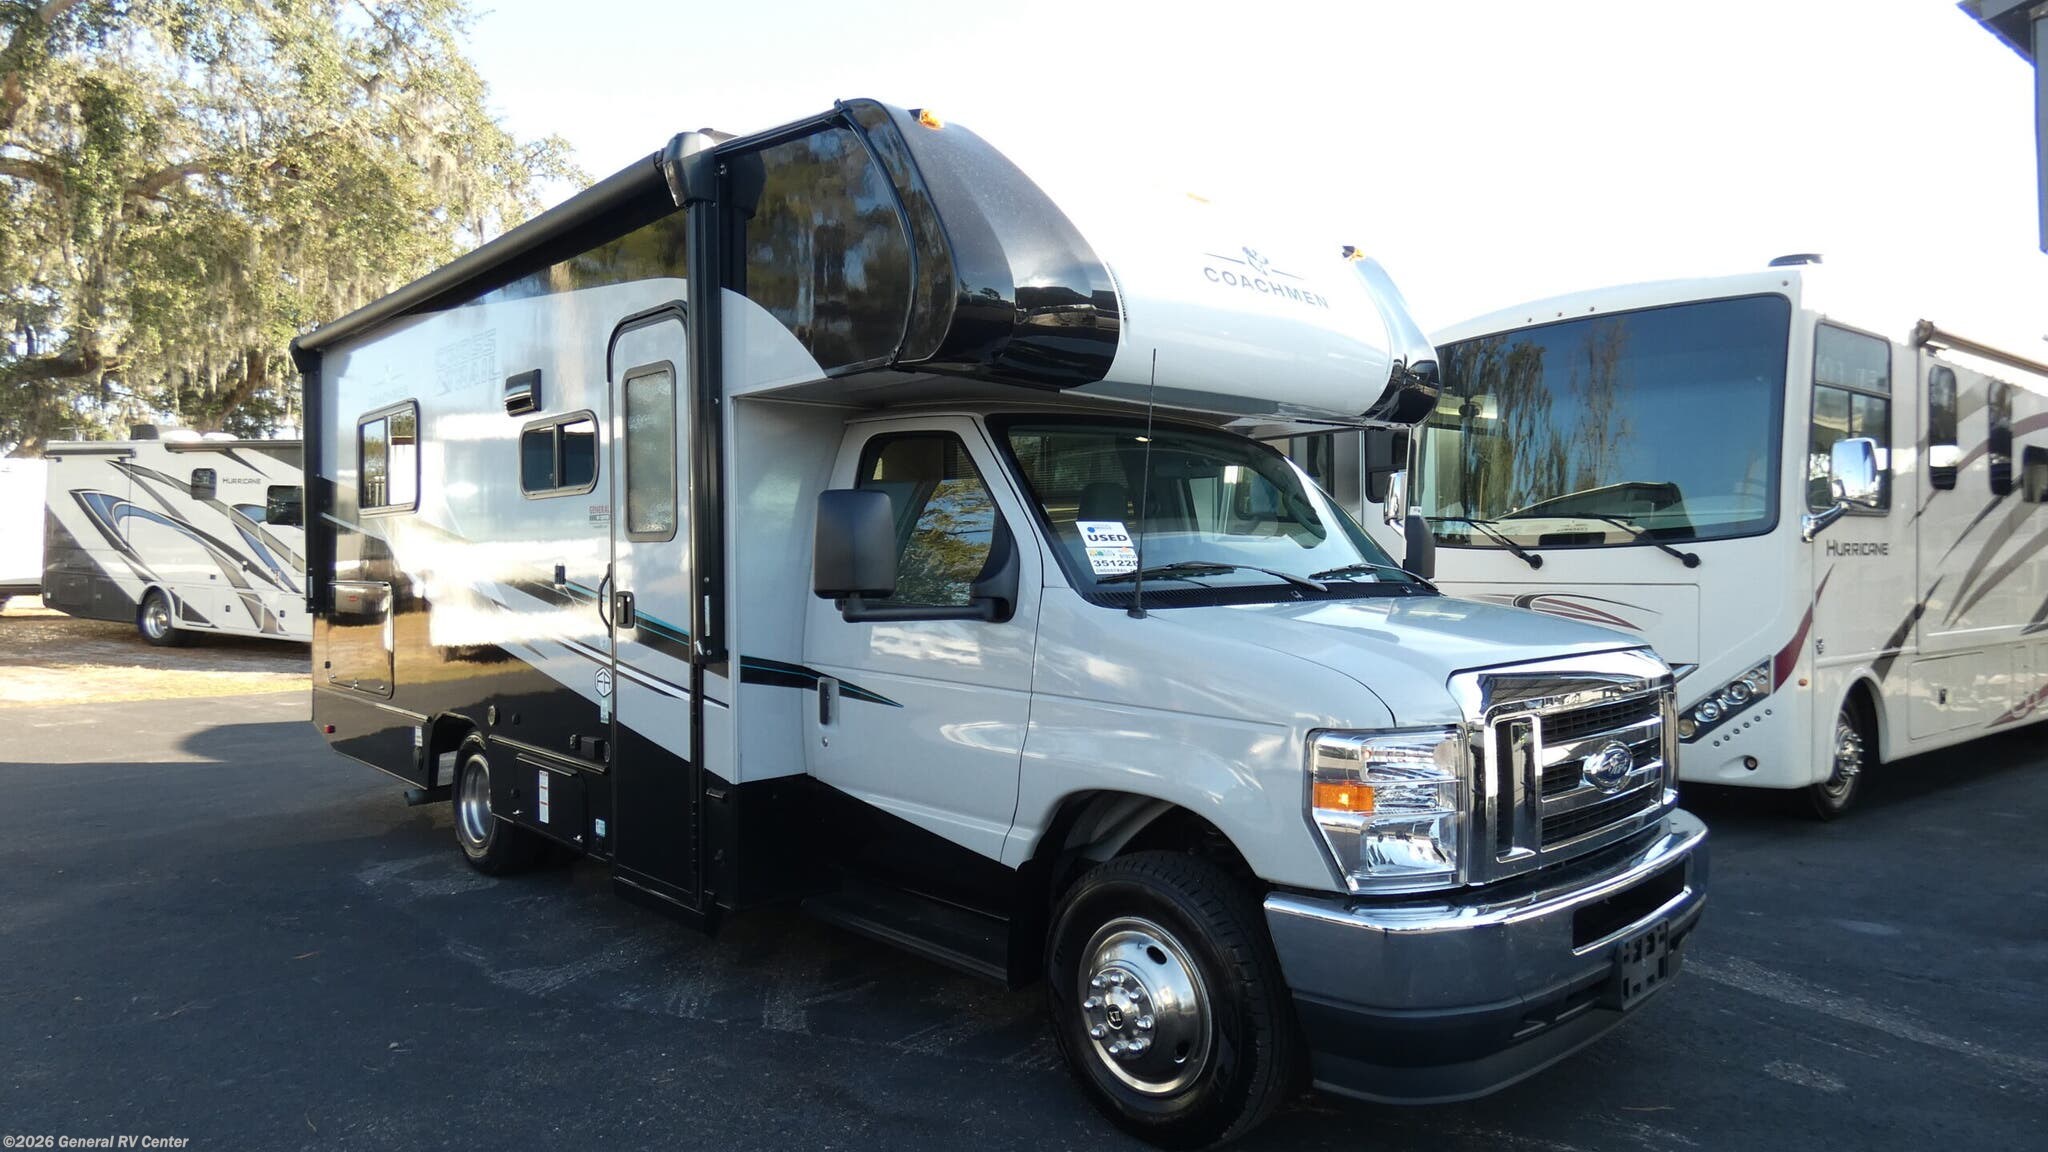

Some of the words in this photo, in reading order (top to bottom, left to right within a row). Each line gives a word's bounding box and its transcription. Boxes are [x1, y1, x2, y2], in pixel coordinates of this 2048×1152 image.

[1203, 267, 1329, 308] COACHMEN
[1087, 534, 1128, 542] USED
[1826, 539, 1889, 556] HURRICANE
